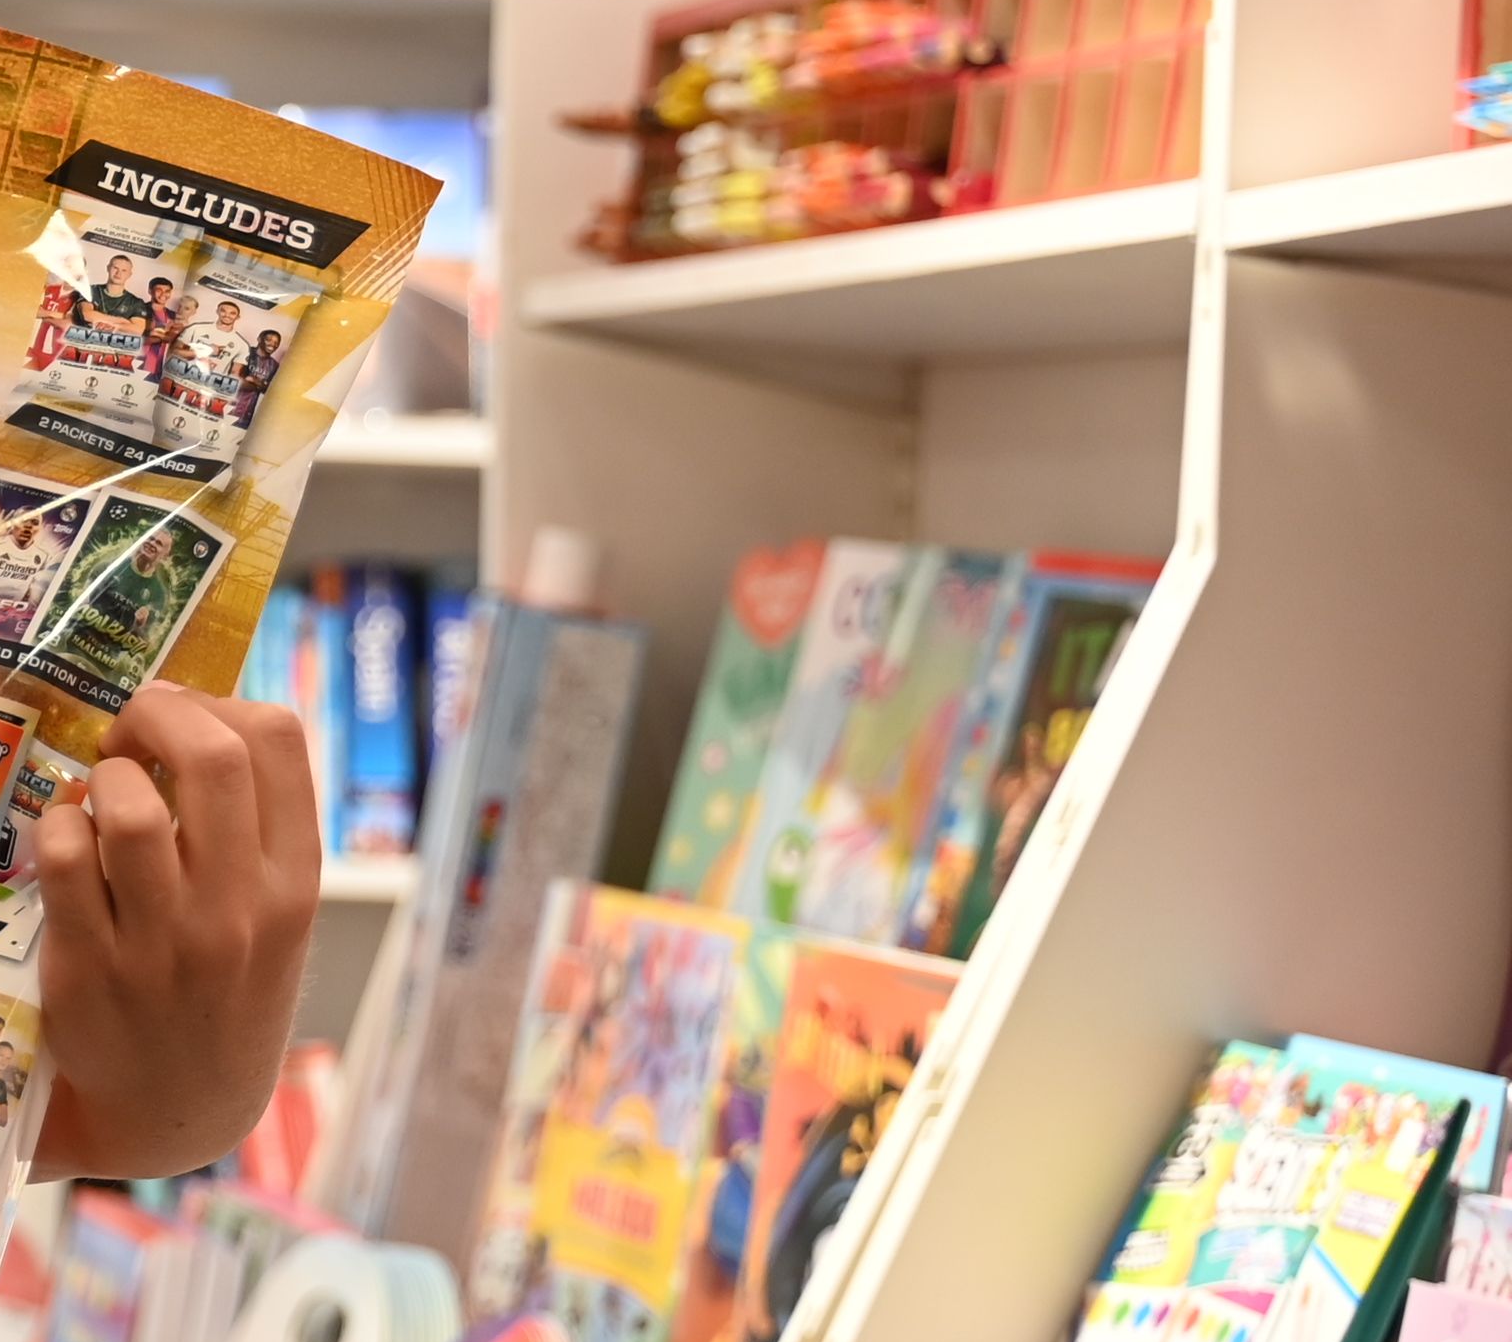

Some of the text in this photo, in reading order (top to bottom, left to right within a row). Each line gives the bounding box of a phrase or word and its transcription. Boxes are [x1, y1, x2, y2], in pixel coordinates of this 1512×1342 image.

[96, 160, 316, 251] INCLUDES
[38, 416, 50, 430] 2
[50, 419, 116, 453] PACKETS
[124, 444, 145, 462] 24
[146, 452, 197, 477] CARDS
[17, 651, 78, 687] EDITION
